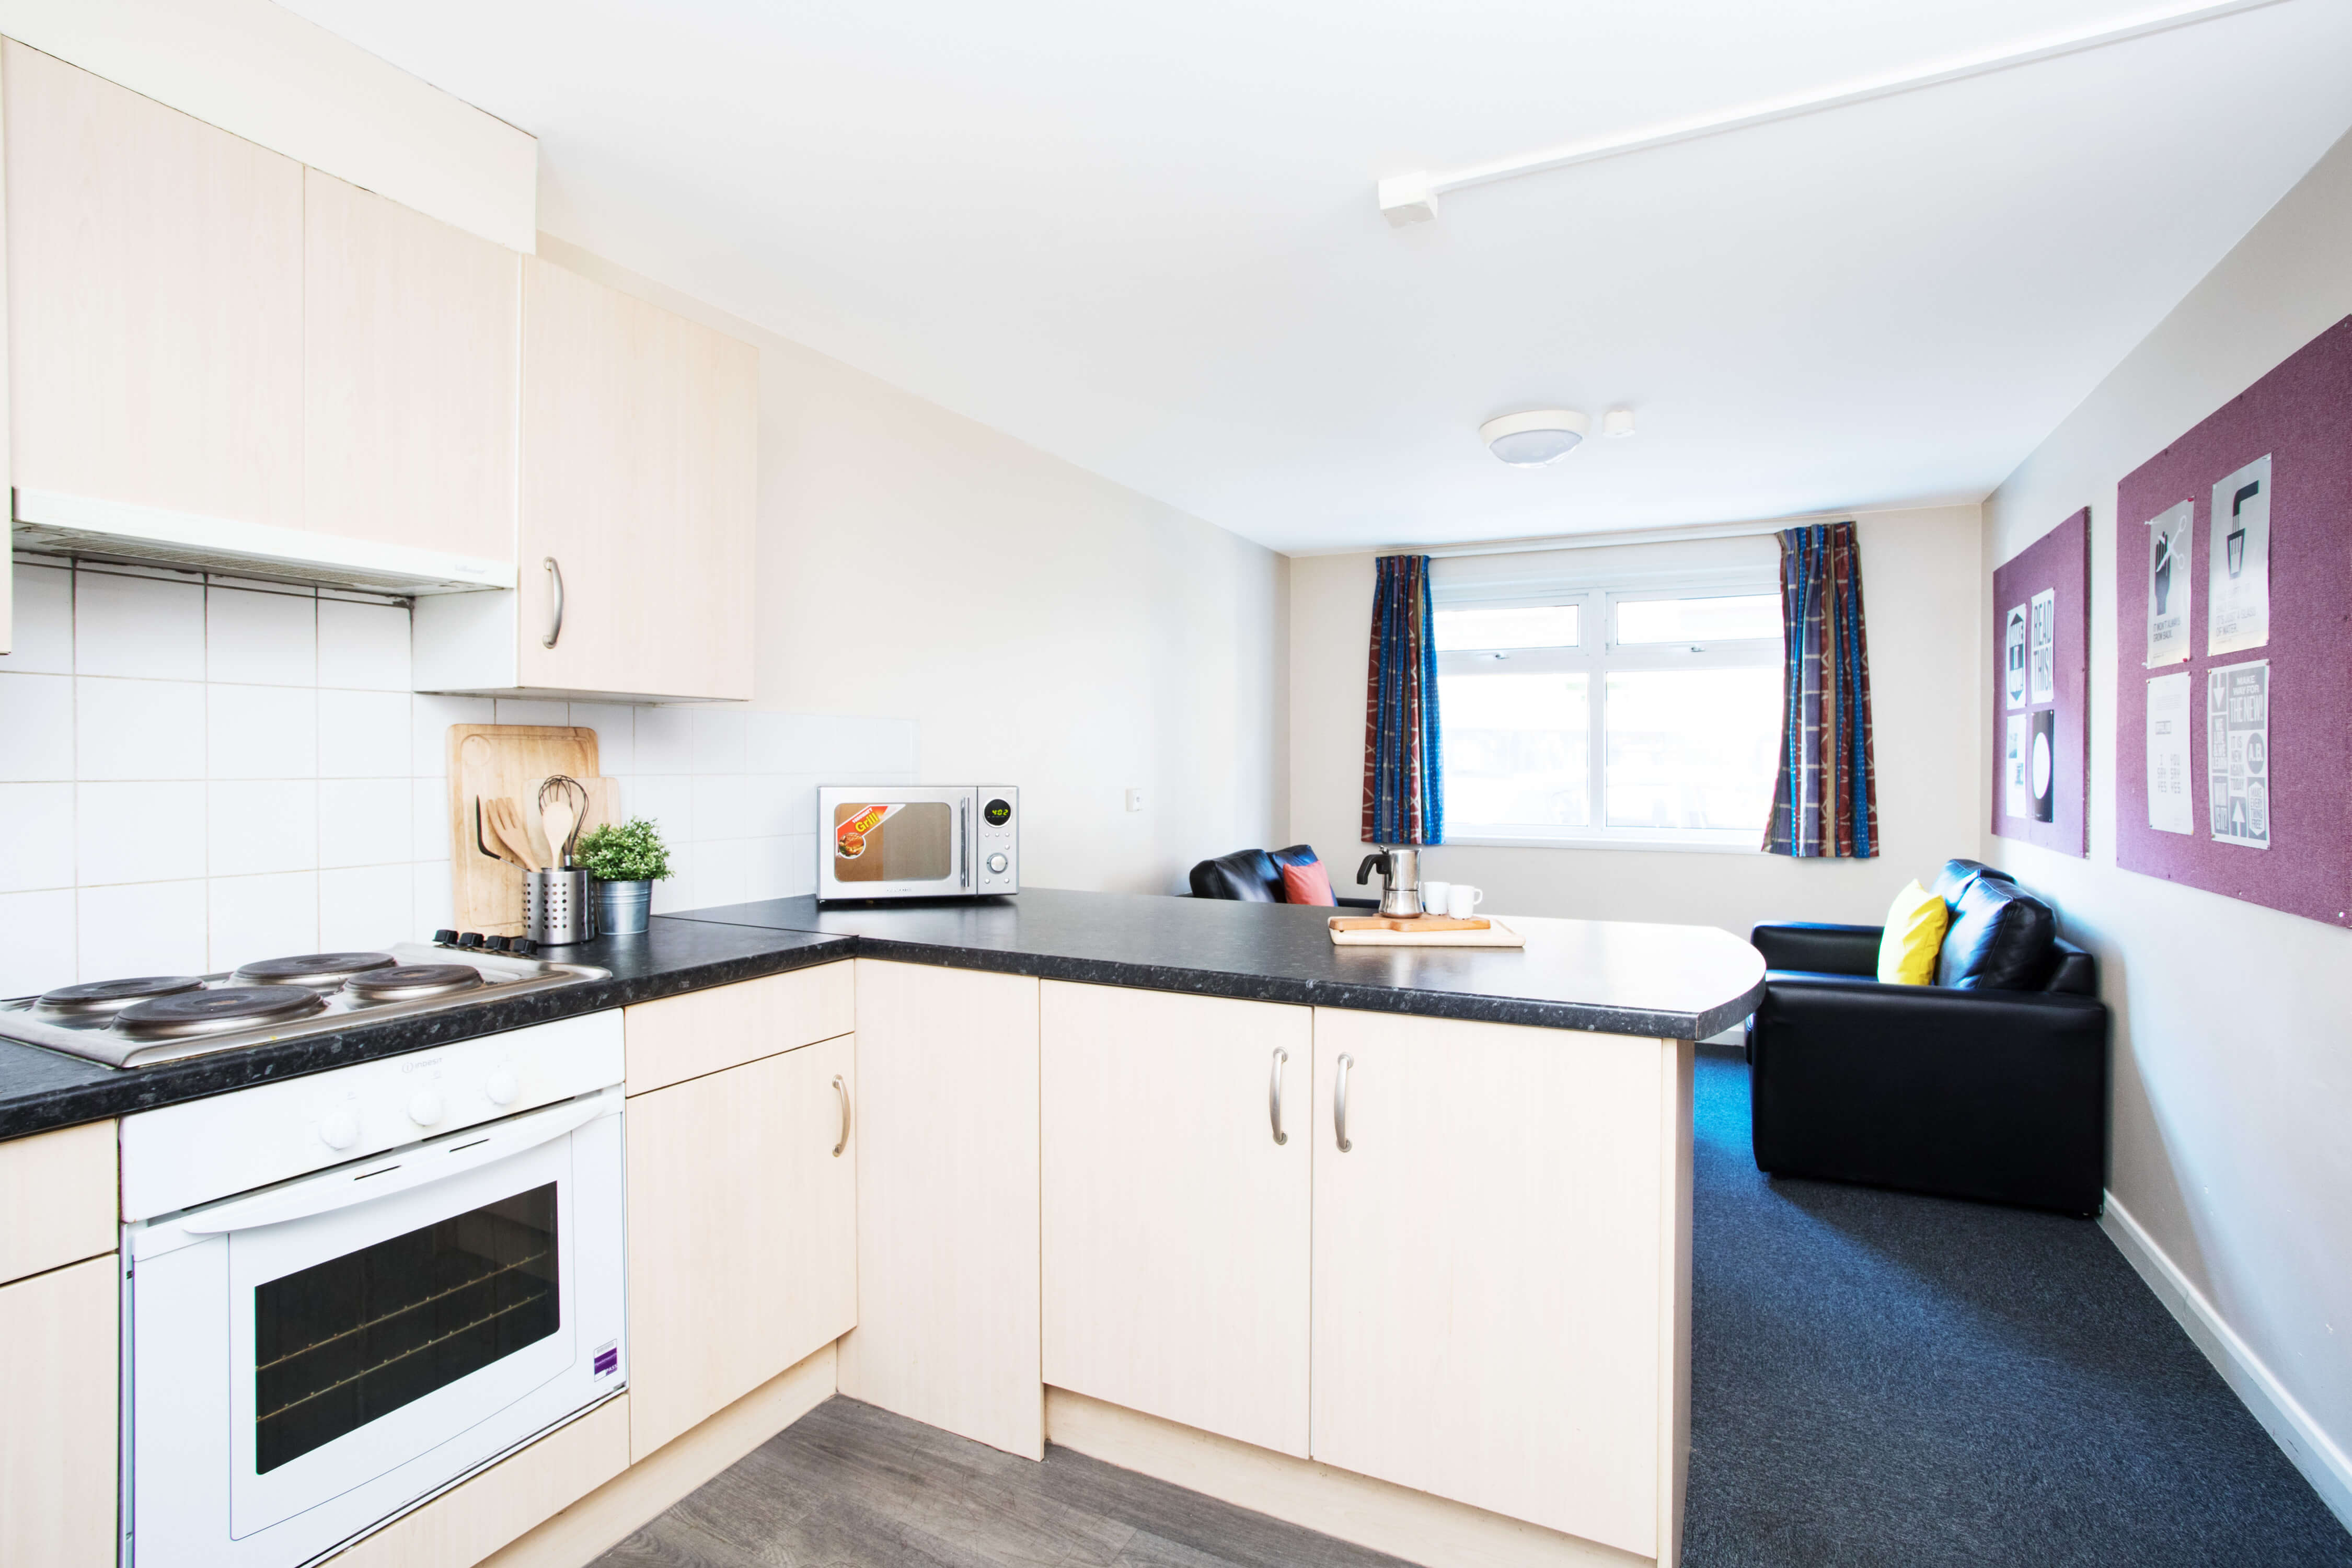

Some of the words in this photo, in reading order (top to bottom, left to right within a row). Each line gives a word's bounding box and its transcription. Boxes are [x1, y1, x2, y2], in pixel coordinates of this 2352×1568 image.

[2034, 600, 2051, 648] READ
[2153, 632, 2163, 643] GROW
[2034, 645, 2051, 691] THIS!
[2236, 675, 2255, 686] MAKE
[2233, 687, 2246, 696] WAY
[2246, 685, 2259, 694] FOR
[2230, 696, 2243, 723] THE
[2243, 694, 2263, 722] NEW!
[2230, 736, 2235, 749] IT
[2236, 735, 2242, 748] IS
[2231, 750, 2242, 763] NEW
[2249, 743, 2263, 762] A.B.
[2157, 767, 2166, 779] SAY
[2170, 767, 2180, 780] SAY
[2230, 764, 2244, 777] AGAIN
[2158, 781, 2167, 792] YES
[2171, 782, 2181, 794] YES
[2230, 778, 2244, 791] TODAY
[2250, 798, 2262, 808] EVERY
[855, 812, 879, 833] Grill
[606, 1364, 618, 1373] PASS
